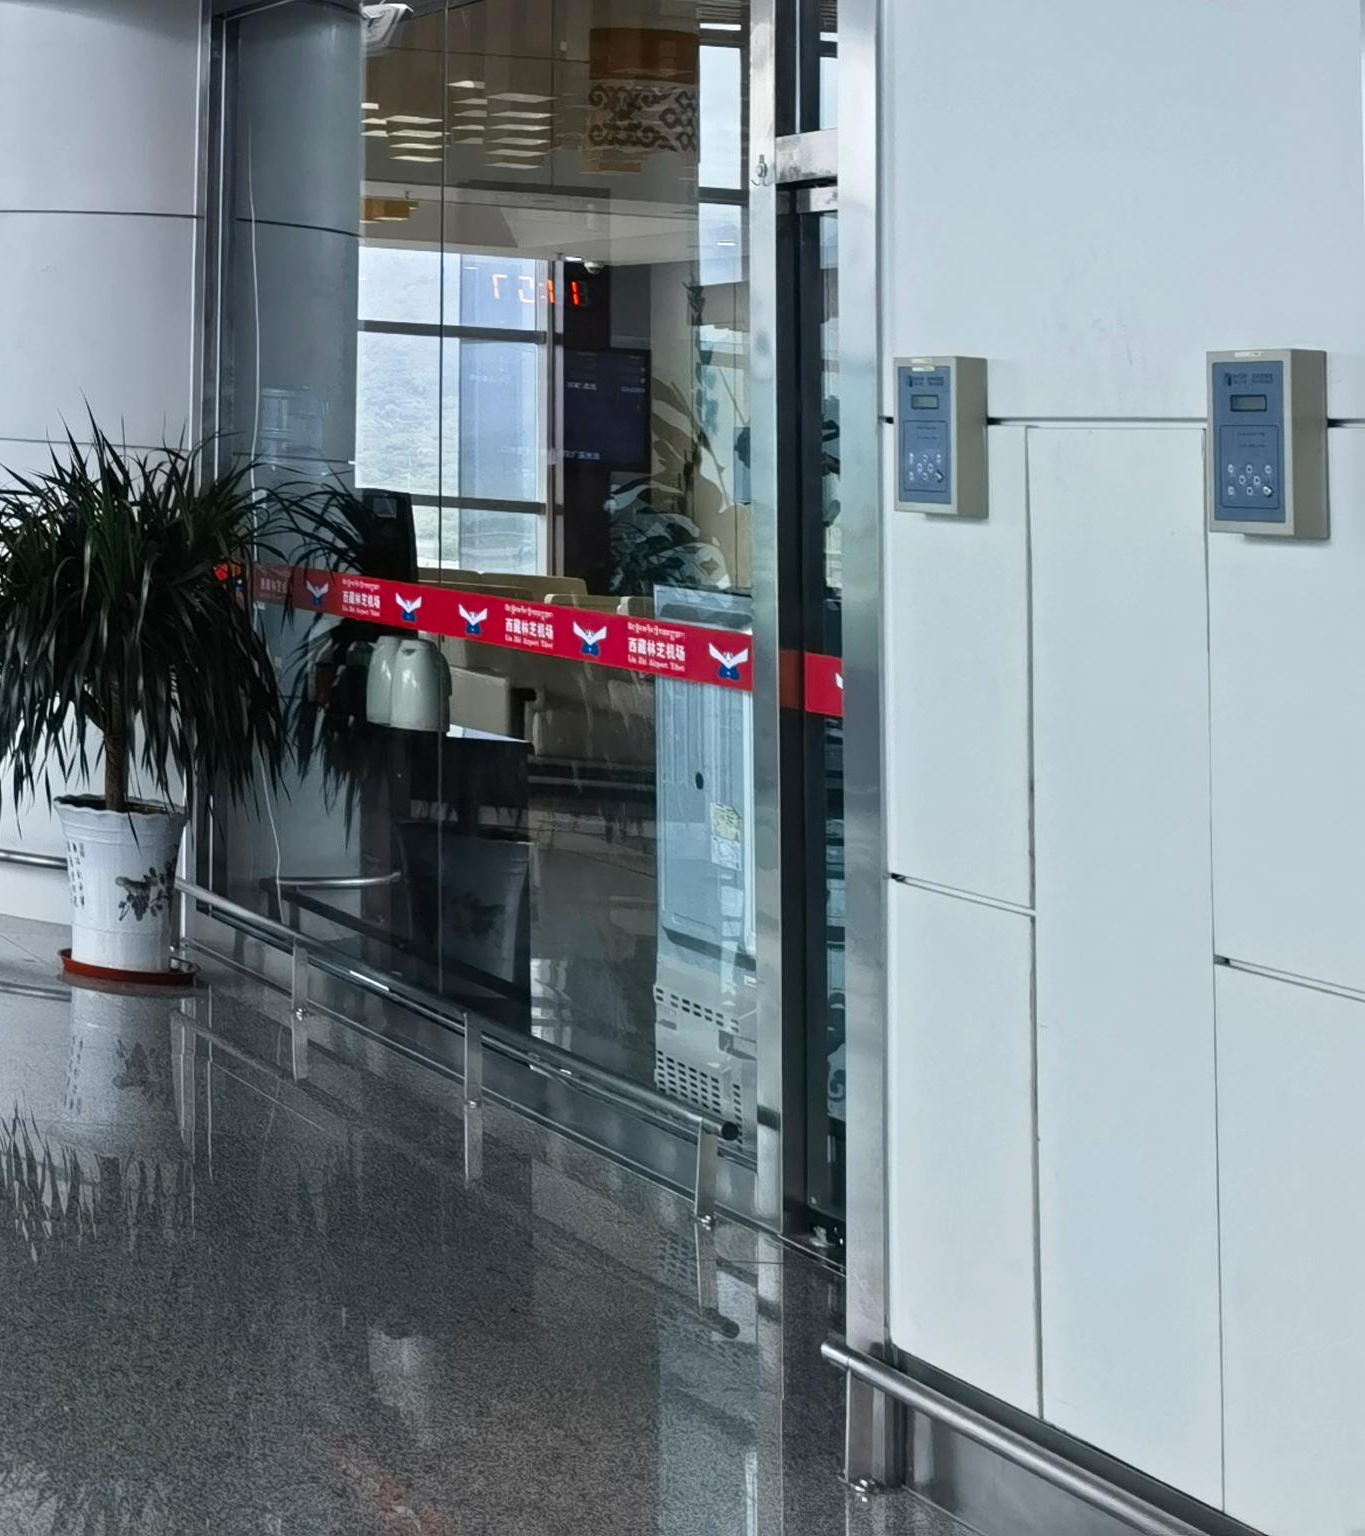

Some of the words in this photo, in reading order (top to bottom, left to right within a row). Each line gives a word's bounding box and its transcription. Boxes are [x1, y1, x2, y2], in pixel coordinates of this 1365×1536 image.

[505, 617, 554, 641] 西藏林芝机场
[627, 637, 686, 662] 西藏林芝机场
